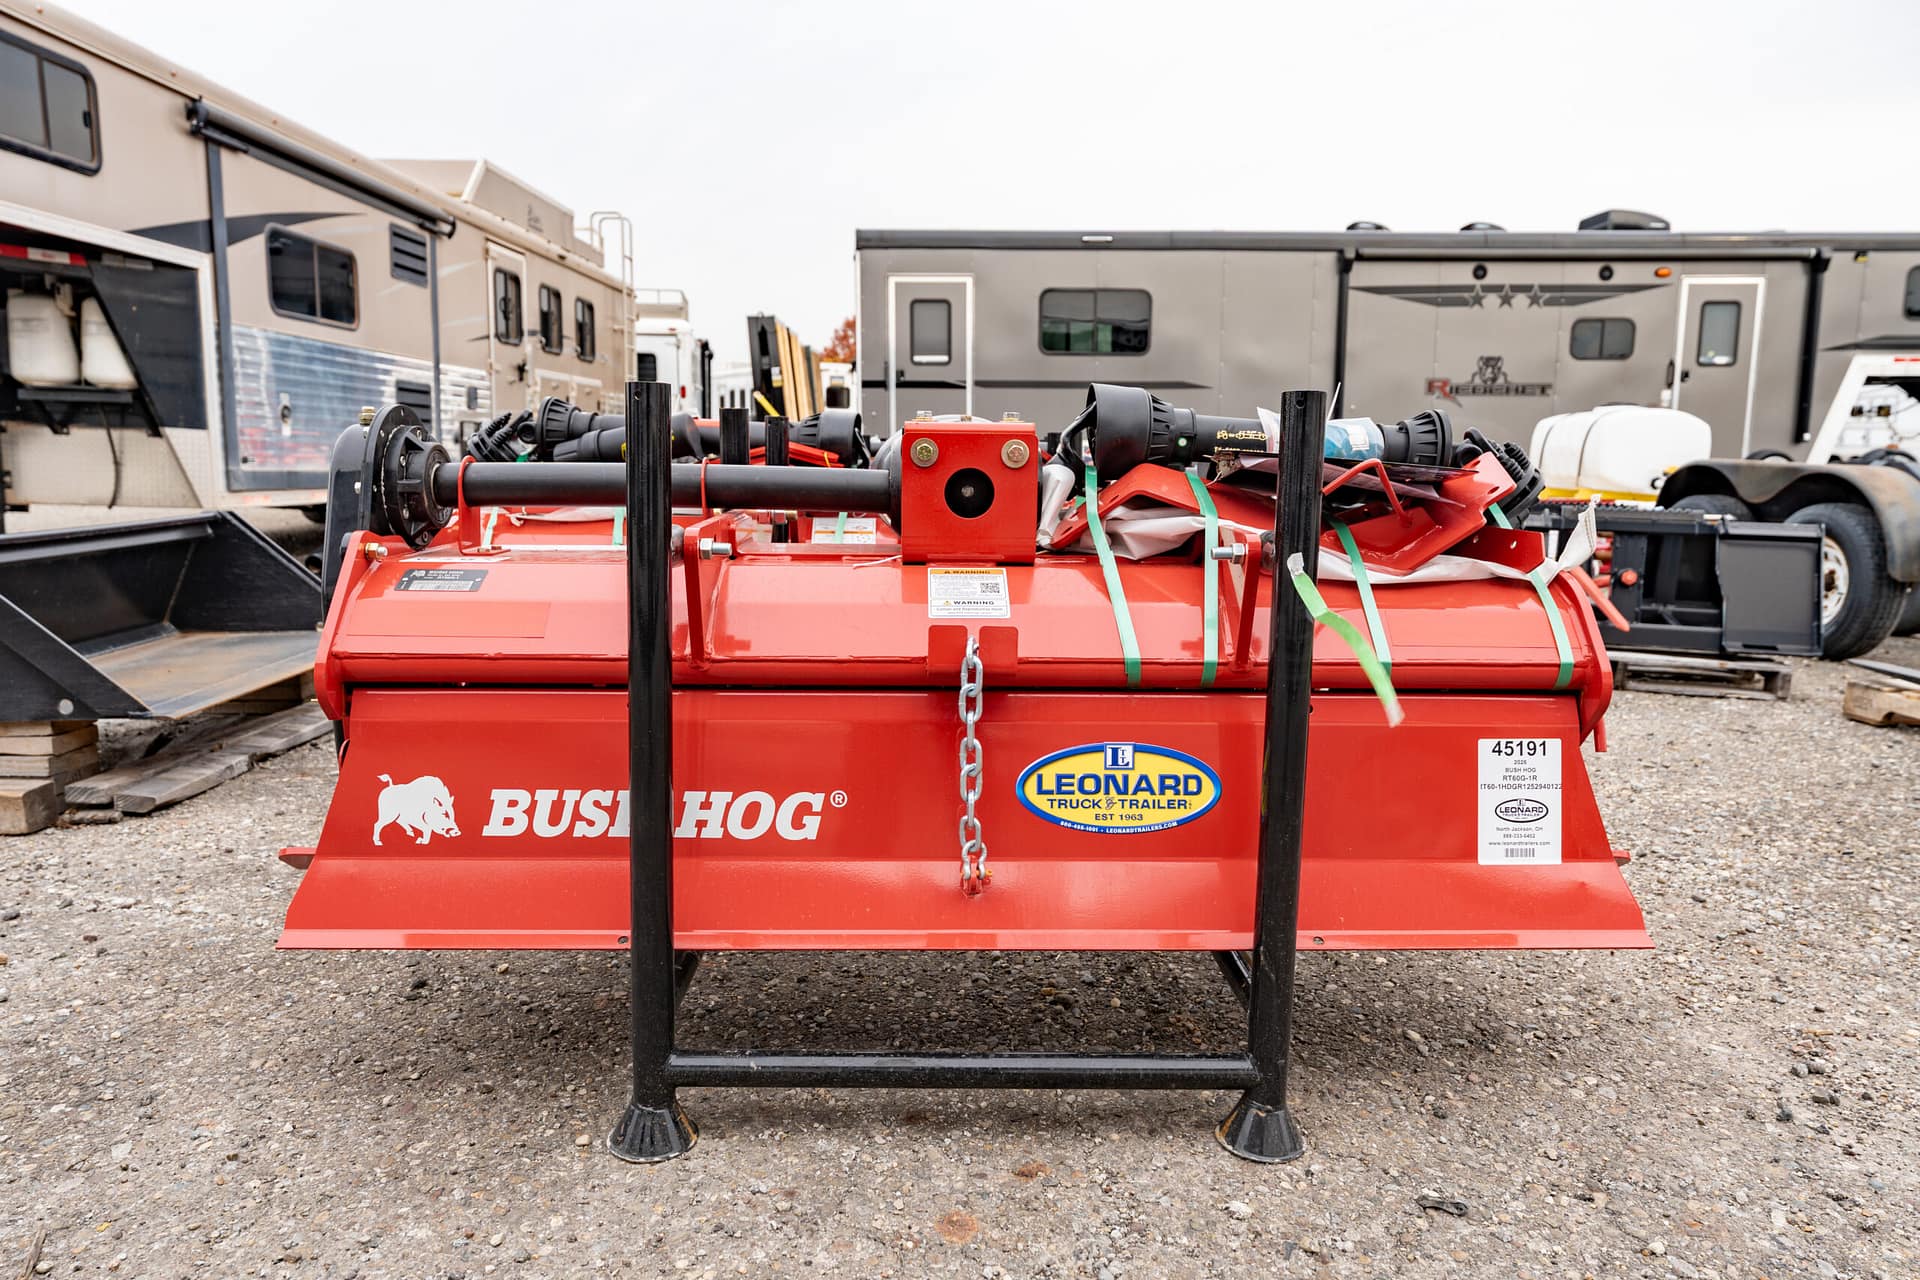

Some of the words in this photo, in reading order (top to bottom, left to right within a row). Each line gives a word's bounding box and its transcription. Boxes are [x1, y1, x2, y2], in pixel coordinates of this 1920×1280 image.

[1491, 740, 1547, 757] 45191
[1036, 773, 1203, 796] LEONARD
[1046, 798, 1102, 809] TRUCK
[1118, 798, 1188, 809] TRAILER
[1499, 806, 1544, 814] LEONARD
[1094, 813, 1115, 821] EST
[1119, 813, 1144, 821] 1963
[1105, 821, 1178, 834] LEONARDTRAILERS.COM
